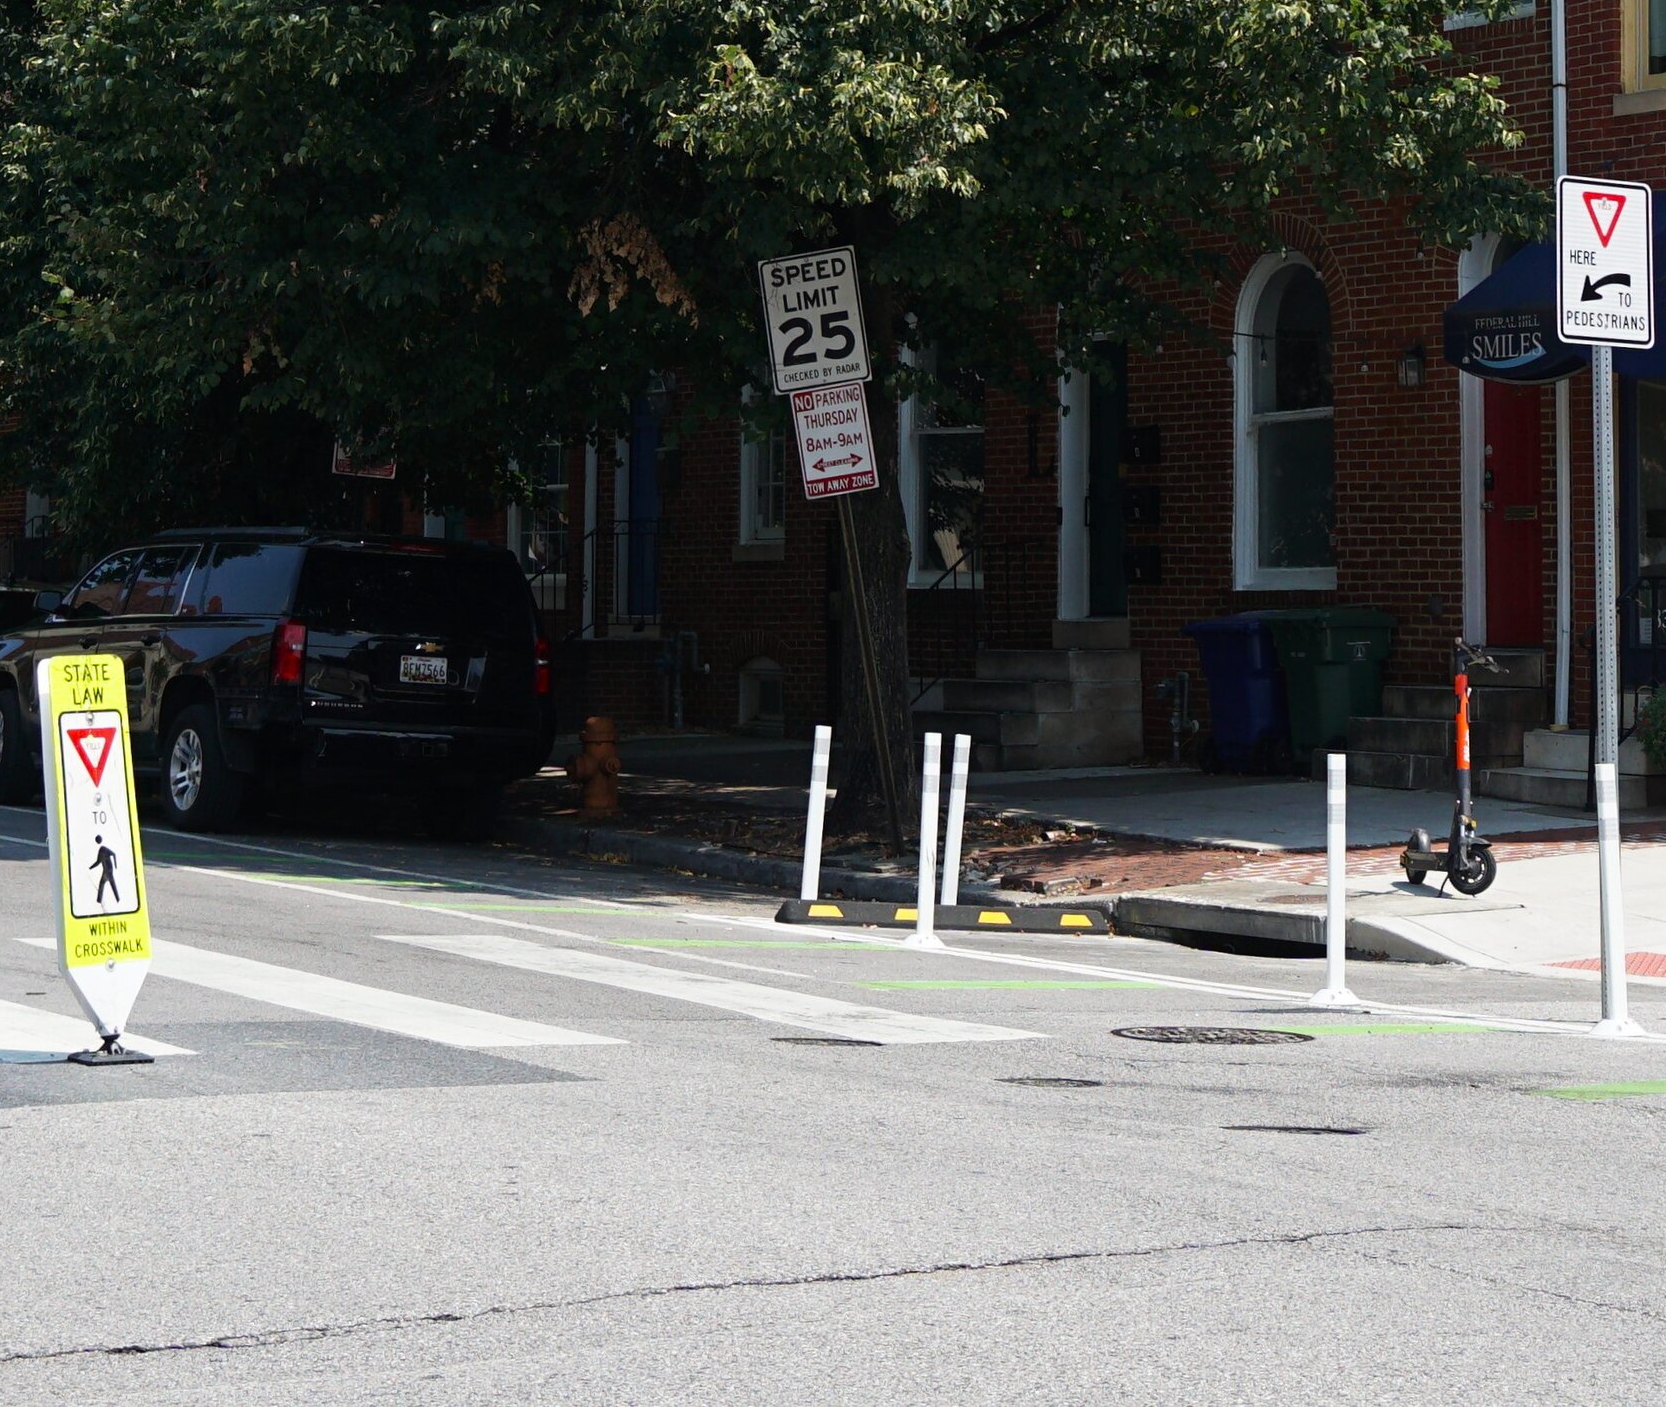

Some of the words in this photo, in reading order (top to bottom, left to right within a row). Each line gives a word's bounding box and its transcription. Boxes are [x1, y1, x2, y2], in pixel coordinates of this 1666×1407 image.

[1569, 249, 1596, 266] HERE
[771, 258, 846, 287] SPEED
[783, 285, 839, 313] LIMIT
[1619, 292, 1632, 308] TO
[1475, 316, 1516, 330] FEDERAL
[1518, 314, 1540, 328] HILL
[1566, 310, 1646, 332] PEDESTRIANS
[779, 310, 856, 367] 25
[1473, 332, 1542, 361] SMILES
[784, 369, 819, 383] CHECKED
[823, 367, 833, 377] BY
[836, 362, 861, 375] RADAR
[795, 395, 813, 412] NO
[815, 387, 860, 409] PARKING
[804, 408, 858, 430] THURSDAY
[806, 432, 863, 452] 8AM-9AM
[807, 482, 825, 495] TOW
[827, 478, 849, 492] AWAY
[851, 473, 874, 488] ZONE
[63, 663, 110, 683] STATE
[73, 686, 104, 706] LAW
[92, 811, 107, 825] TO
[89, 921, 127, 937] WITHIN
[75, 939, 143, 958] CROSSWALK
